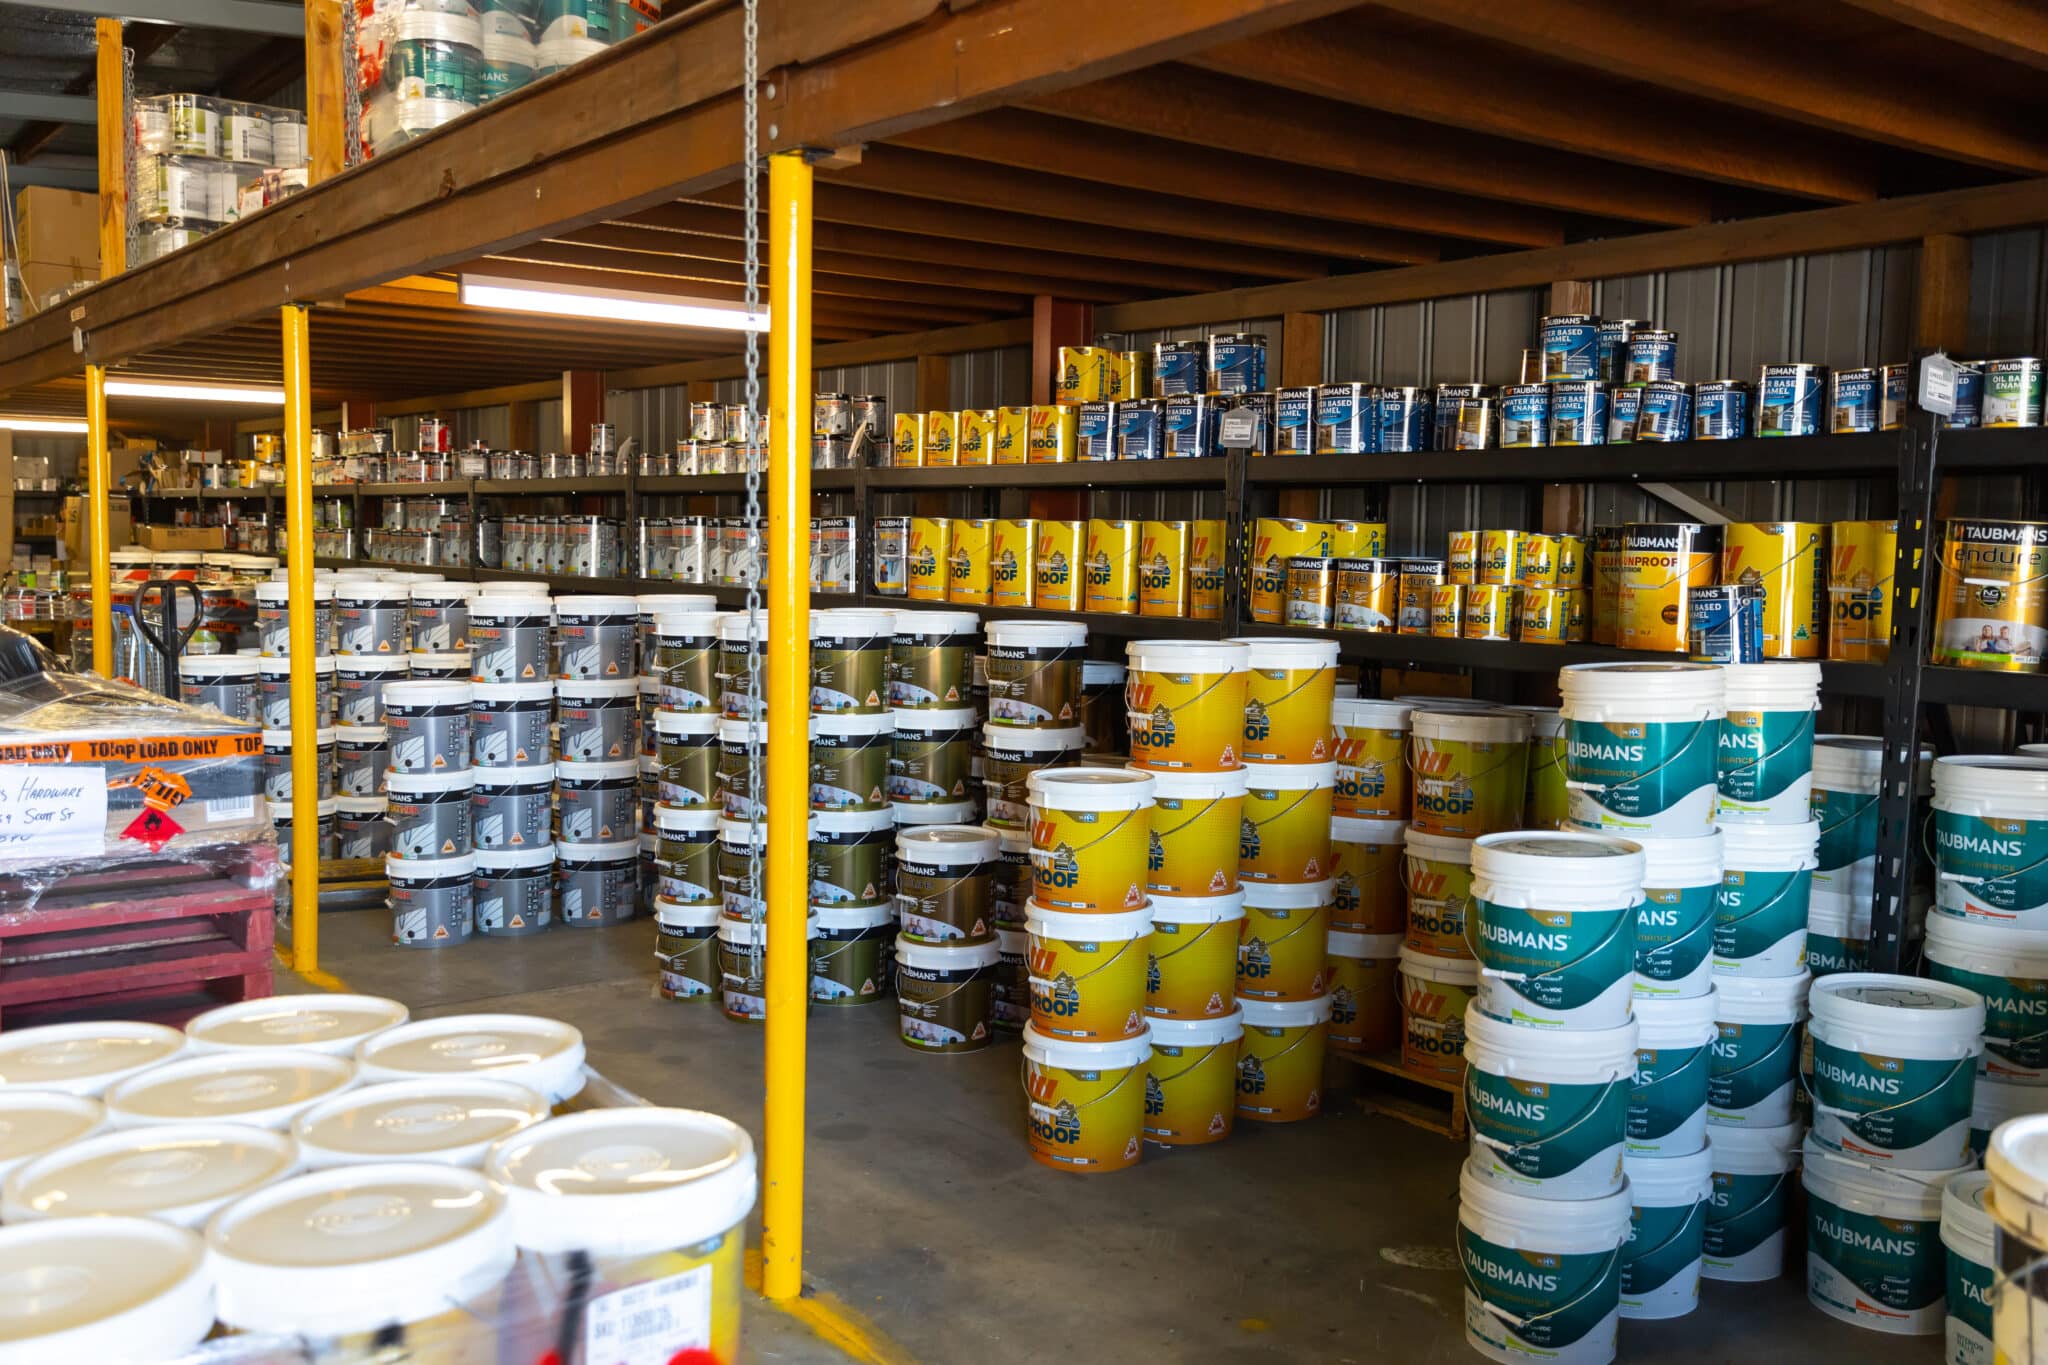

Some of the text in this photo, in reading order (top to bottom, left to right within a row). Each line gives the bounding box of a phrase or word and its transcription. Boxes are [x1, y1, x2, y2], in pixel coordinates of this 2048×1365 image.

[480, 72, 509, 82] MANS
[1328, 399, 1352, 407] BASED
[1512, 404, 1544, 412] ENAMEL
[1955, 547, 2042, 566] endure
[139, 741, 179, 759] LOAD
[182, 739, 218, 756] ONLY
[234, 737, 262, 752] TOP
[814, 738, 837, 746] MANS
[1133, 731, 1175, 748] ROOF
[1567, 742, 1643, 762] AUBMANS
[1334, 781, 1385, 798] ROOF
[1416, 795, 1474, 815] PROOF
[1937, 828, 2022, 857] TAUBMANS
[1000, 855, 1024, 864] MANS
[1034, 870, 1079, 889] ROOF
[1411, 913, 1467, 936] PROOF
[1478, 919, 1568, 951] TAUBMANS
[1986, 996, 2048, 1016] MANS
[1814, 1056, 1900, 1095] TAUBMANS
[1469, 1083, 1546, 1121] AUBMANS
[1815, 1215, 1916, 1256] TAUBMANS
[1466, 1248, 1558, 1292] TAUBMANS
